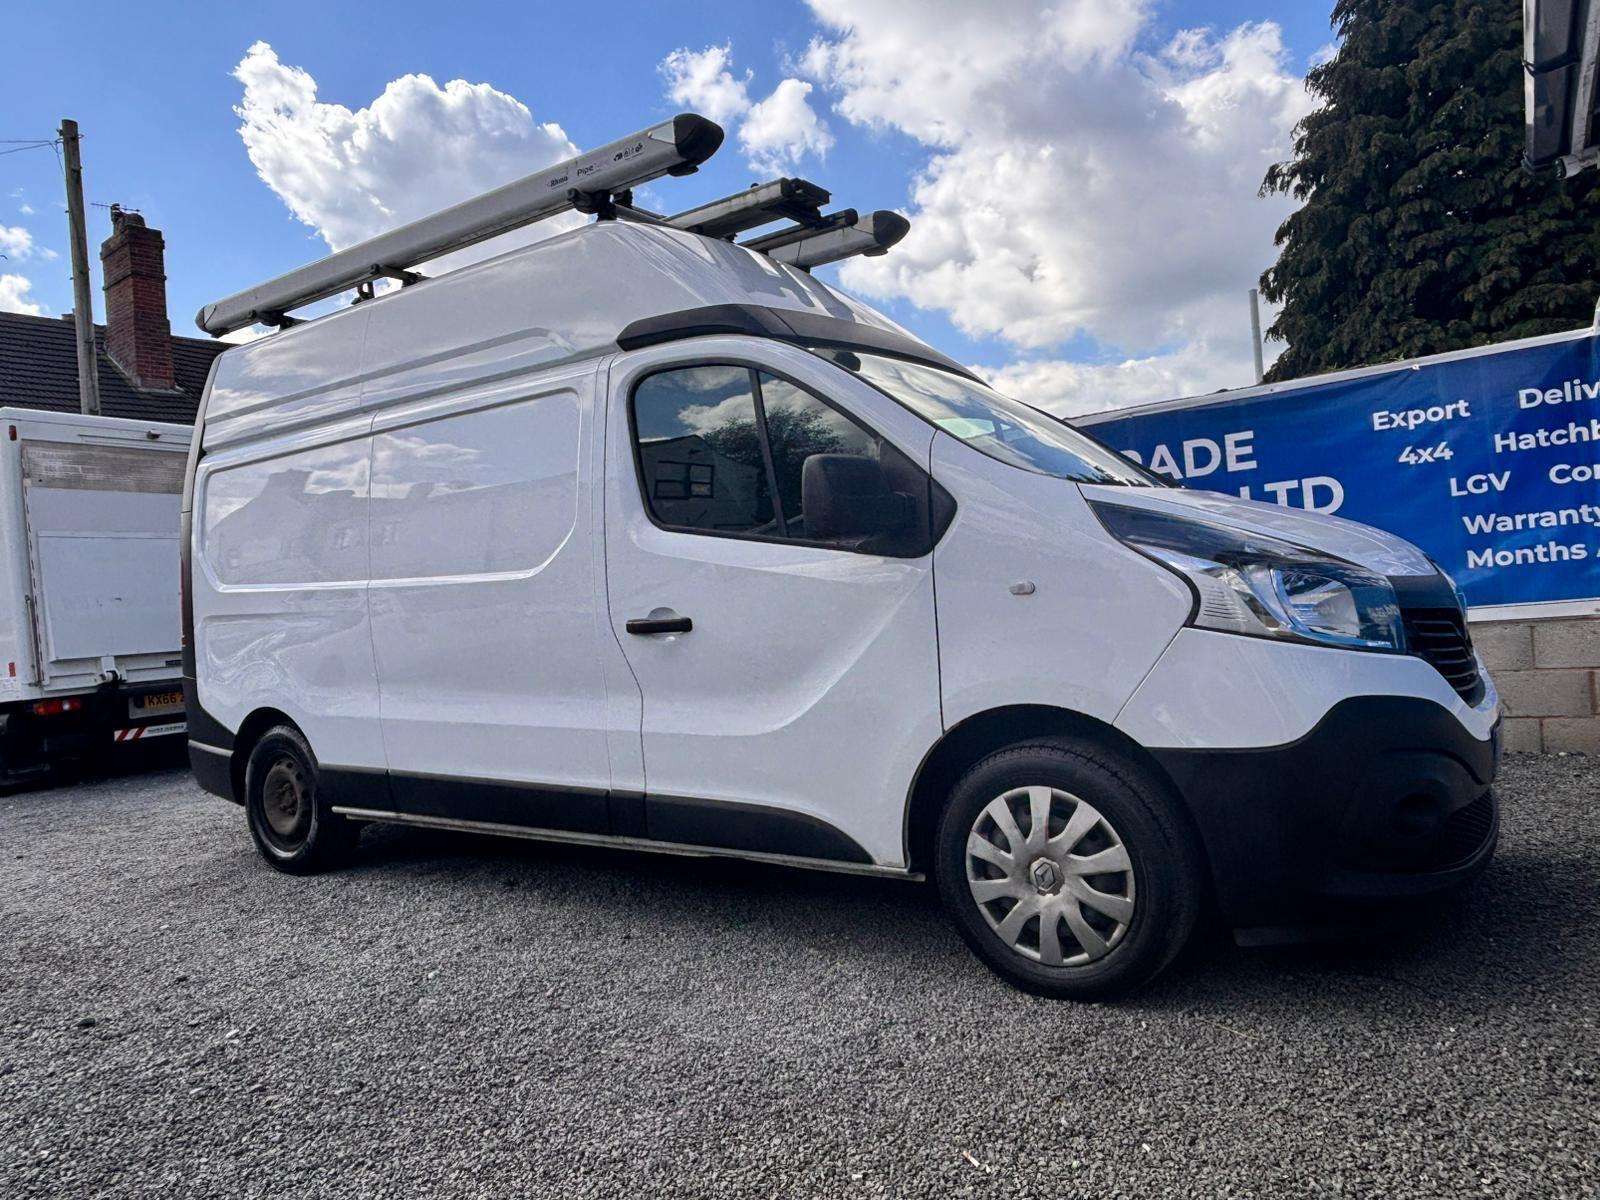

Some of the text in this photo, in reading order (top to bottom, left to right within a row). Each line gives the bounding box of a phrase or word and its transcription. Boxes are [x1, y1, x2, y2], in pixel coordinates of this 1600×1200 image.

[1372, 400, 1472, 431] Export
[1398, 441, 1454, 465] 4x4
[1450, 471, 1511, 497] LGV
[1467, 541, 1588, 569] Months
[147, 693, 177, 706] KX66
